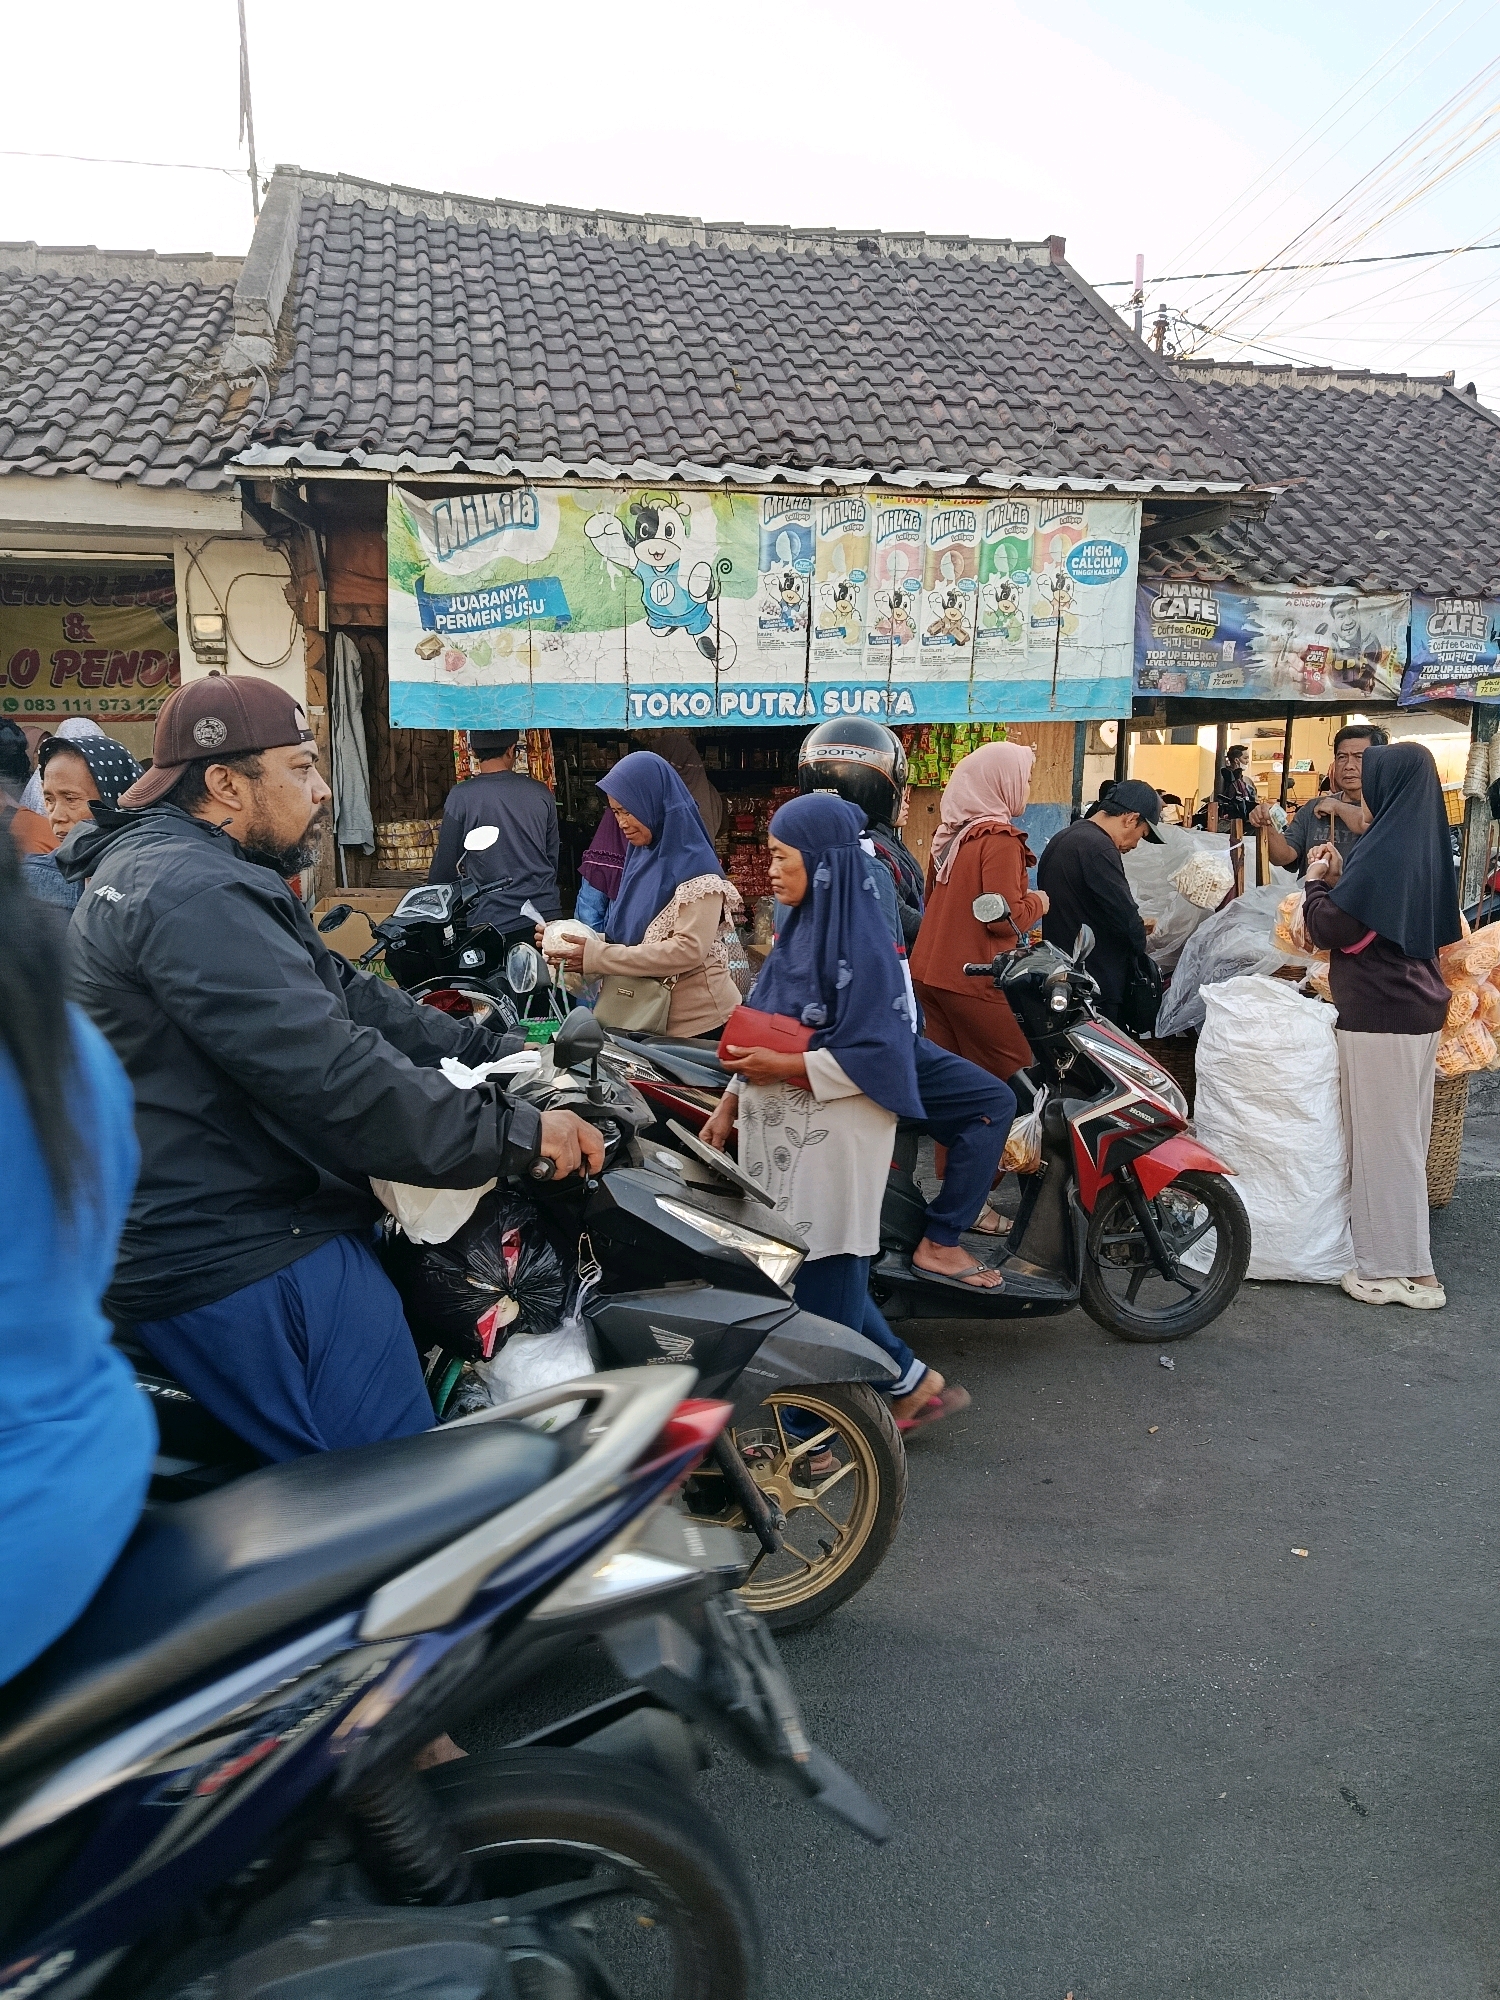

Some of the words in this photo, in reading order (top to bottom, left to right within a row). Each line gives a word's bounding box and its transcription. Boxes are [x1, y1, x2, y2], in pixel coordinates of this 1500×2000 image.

[1083, 545, 1111, 557] HIGH
[1072, 557, 1122, 568] CALCIUM
[449, 584, 529, 612] JUARANYA
[1163, 583, 1209, 599] MARI
[1153, 598, 1217, 621] CAFE
[1293, 599, 1327, 608] ENERGY
[1438, 600, 1480, 615] MARI
[435, 608, 502, 630] PERMEN
[504, 598, 545, 620] SUSU
[64, 612, 96, 642] &
[1157, 625, 1184, 636] Coffee
[1185, 624, 1212, 637] Candy
[1428, 615, 1485, 636] CAFE
[1433, 640, 1459, 651] Coffee
[1460, 641, 1483, 651] Candy
[1146, 650, 1166, 659] TOP
[1168, 651, 1180, 660] UP
[1181, 652, 1219, 661] ENERGY
[0, 648, 41, 687] O
[1422, 665, 1440, 674] TOP
[1440, 665, 1453, 673] UP
[1454, 665, 1490, 673] ENERGY
[24, 699, 55, 711] 083
[62, 699, 92, 711] 111
[99, 699, 131, 711] 973
[630, 691, 712, 717] TOKO
[720, 691, 815, 716] PUTRA
[823, 690, 915, 714] SURYA
[1129, 1106, 1155, 1124] HONDA
[646, 1353, 695, 1366] HONDA
